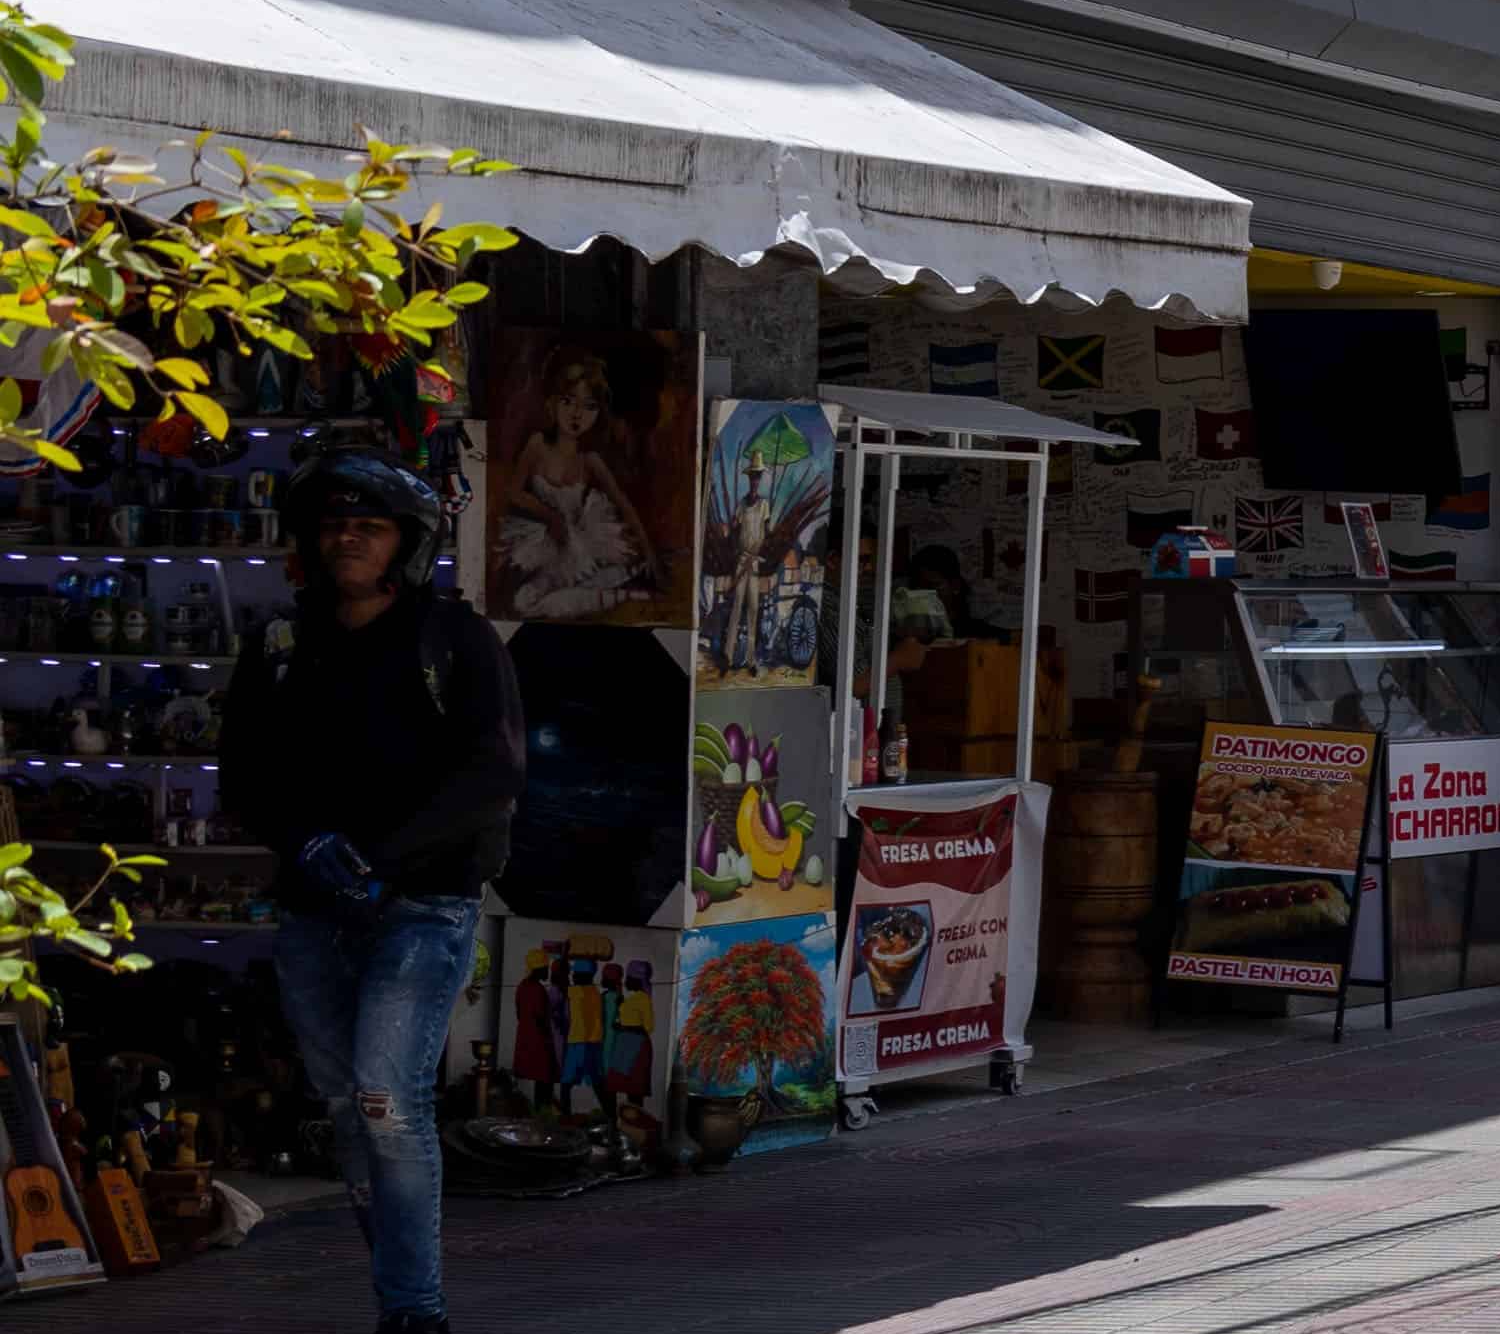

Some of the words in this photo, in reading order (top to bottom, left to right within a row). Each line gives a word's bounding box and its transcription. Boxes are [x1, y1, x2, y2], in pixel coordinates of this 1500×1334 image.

[1214, 736, 1367, 765] PATIMONGO
[1267, 766, 1298, 778] PATA
[1300, 768, 1319, 779] DE
[1319, 770, 1352, 782] VACA
[1423, 762, 1488, 799] Zona
[880, 841, 930, 864] FRESA
[934, 835, 997, 860] CREMA
[938, 923, 976, 942] FRESA
[980, 916, 1008, 934] CON
[1169, 957, 1243, 978] PASTEL
[1248, 964, 1277, 980] EN
[1280, 967, 1335, 985] HOJA
[881, 1033, 931, 1057] FRESA
[936, 1021, 990, 1046] CREMA
